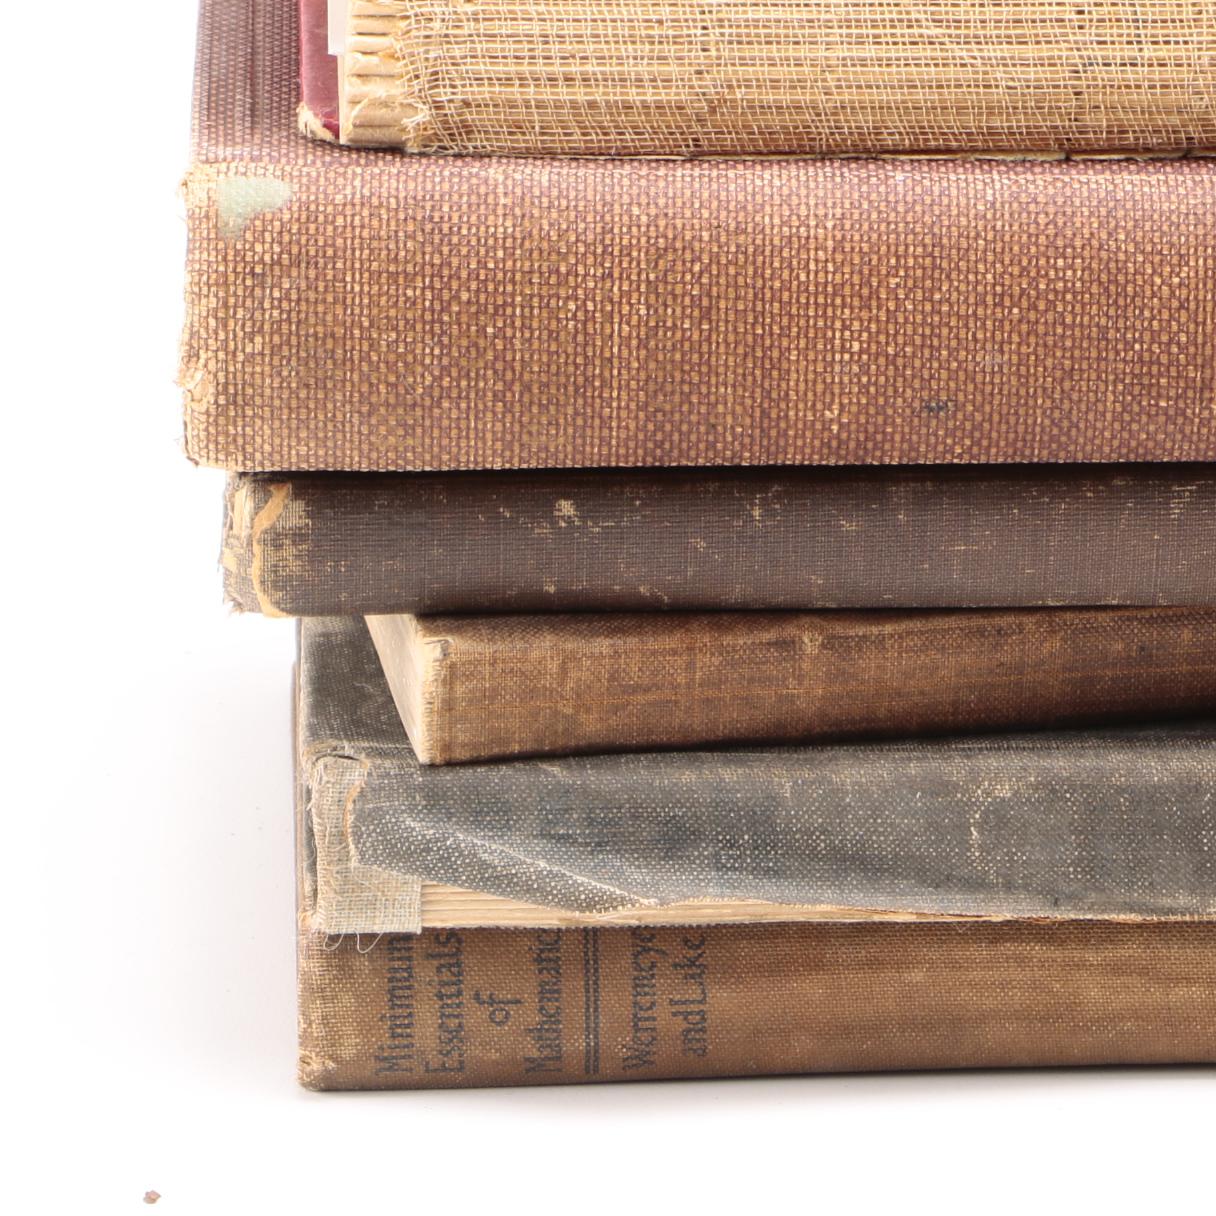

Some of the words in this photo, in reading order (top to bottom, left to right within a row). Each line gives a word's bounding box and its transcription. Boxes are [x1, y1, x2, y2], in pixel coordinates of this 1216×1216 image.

[669, 935, 708, 1007] Lake
[424, 932, 465, 1073] Essentials
[473, 990, 523, 1027] of
[671, 1009, 708, 1057] and
